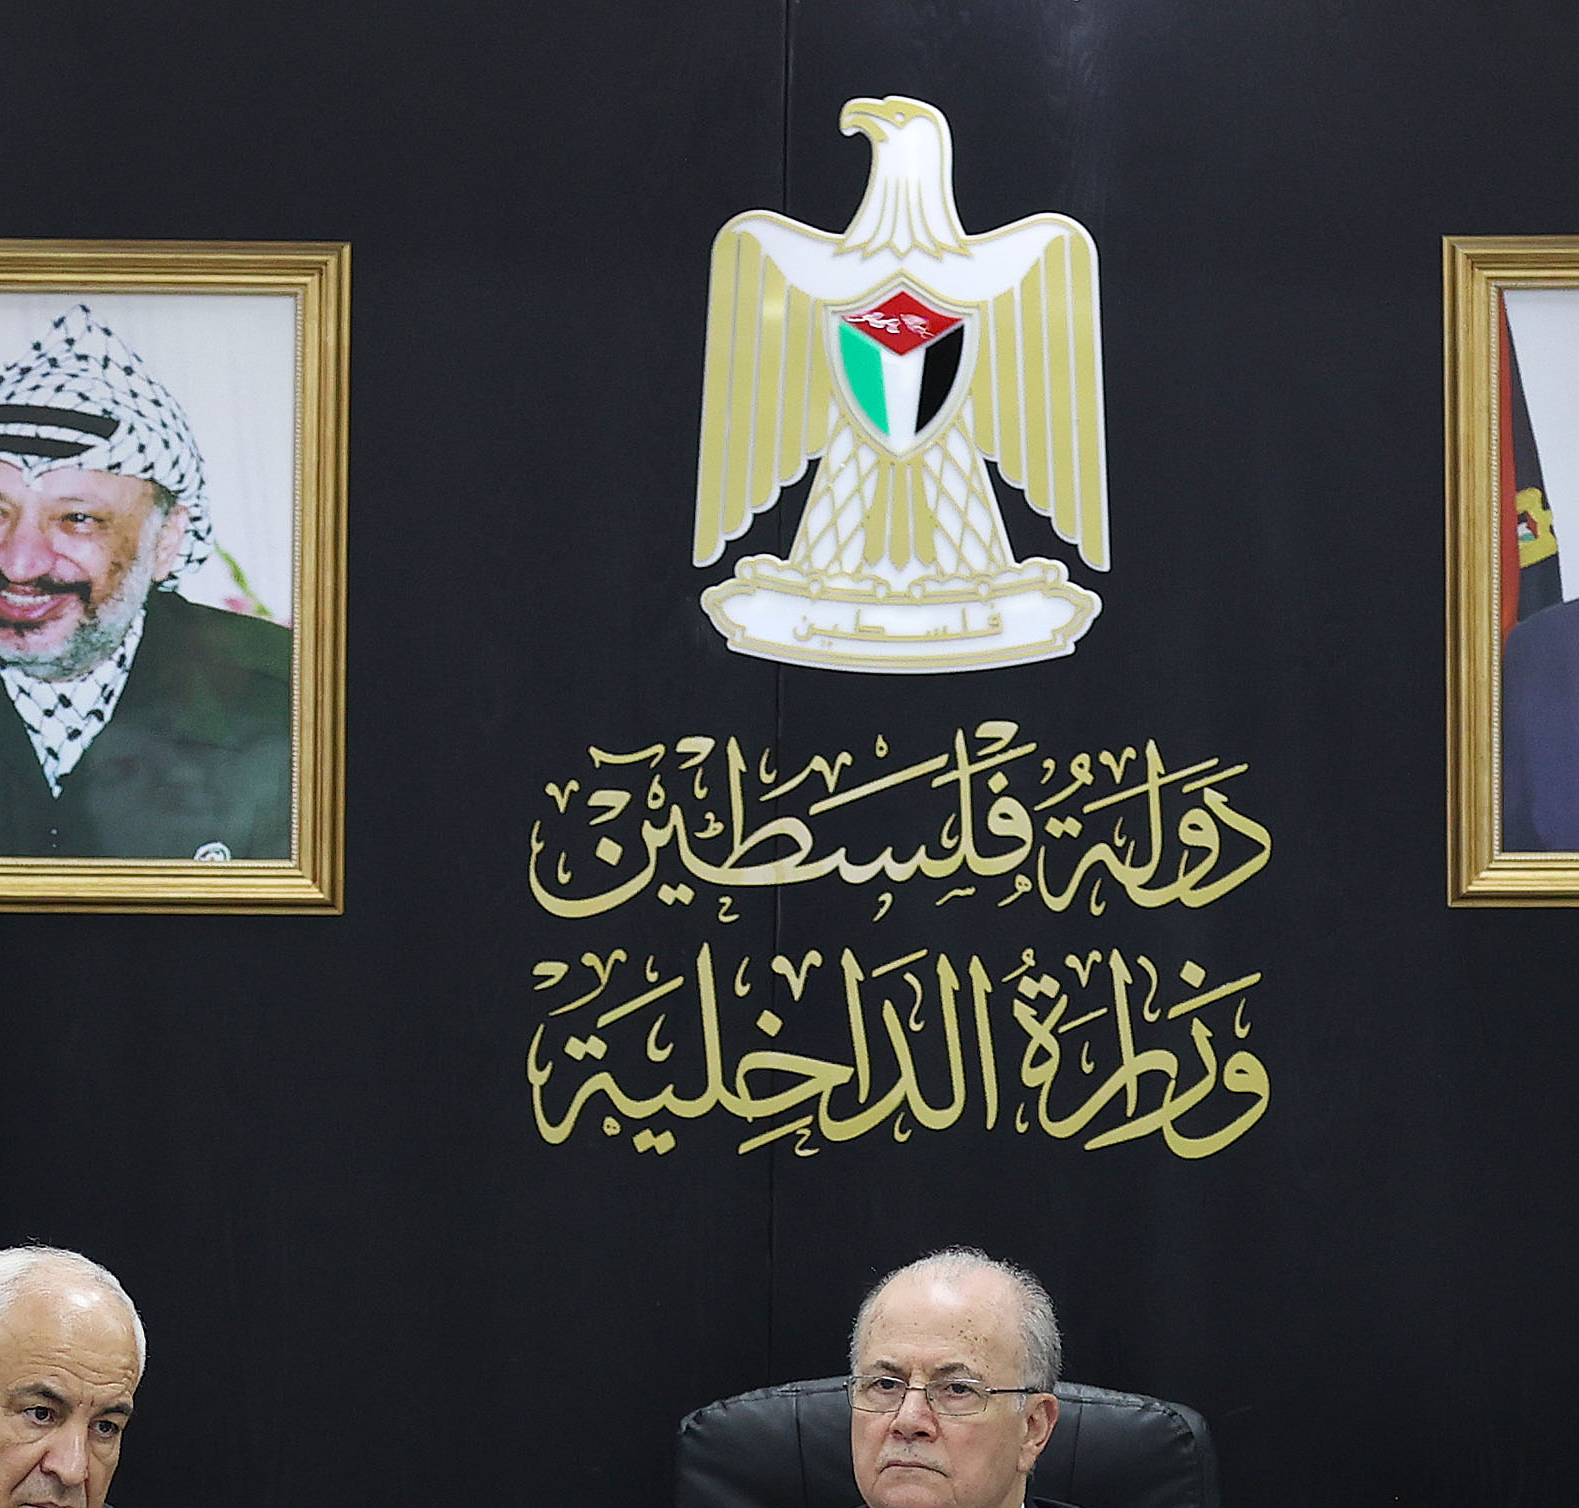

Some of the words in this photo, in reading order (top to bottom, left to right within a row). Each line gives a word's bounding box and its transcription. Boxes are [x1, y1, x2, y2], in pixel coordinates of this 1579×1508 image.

[793, 602, 1003, 648] فلسطين
[529, 721, 1037, 922] فلسطين
[1035, 739, 1273, 917] دولة
[526, 942, 1000, 1158] الداخلية
[1014, 947, 1272, 1160] وزارة
